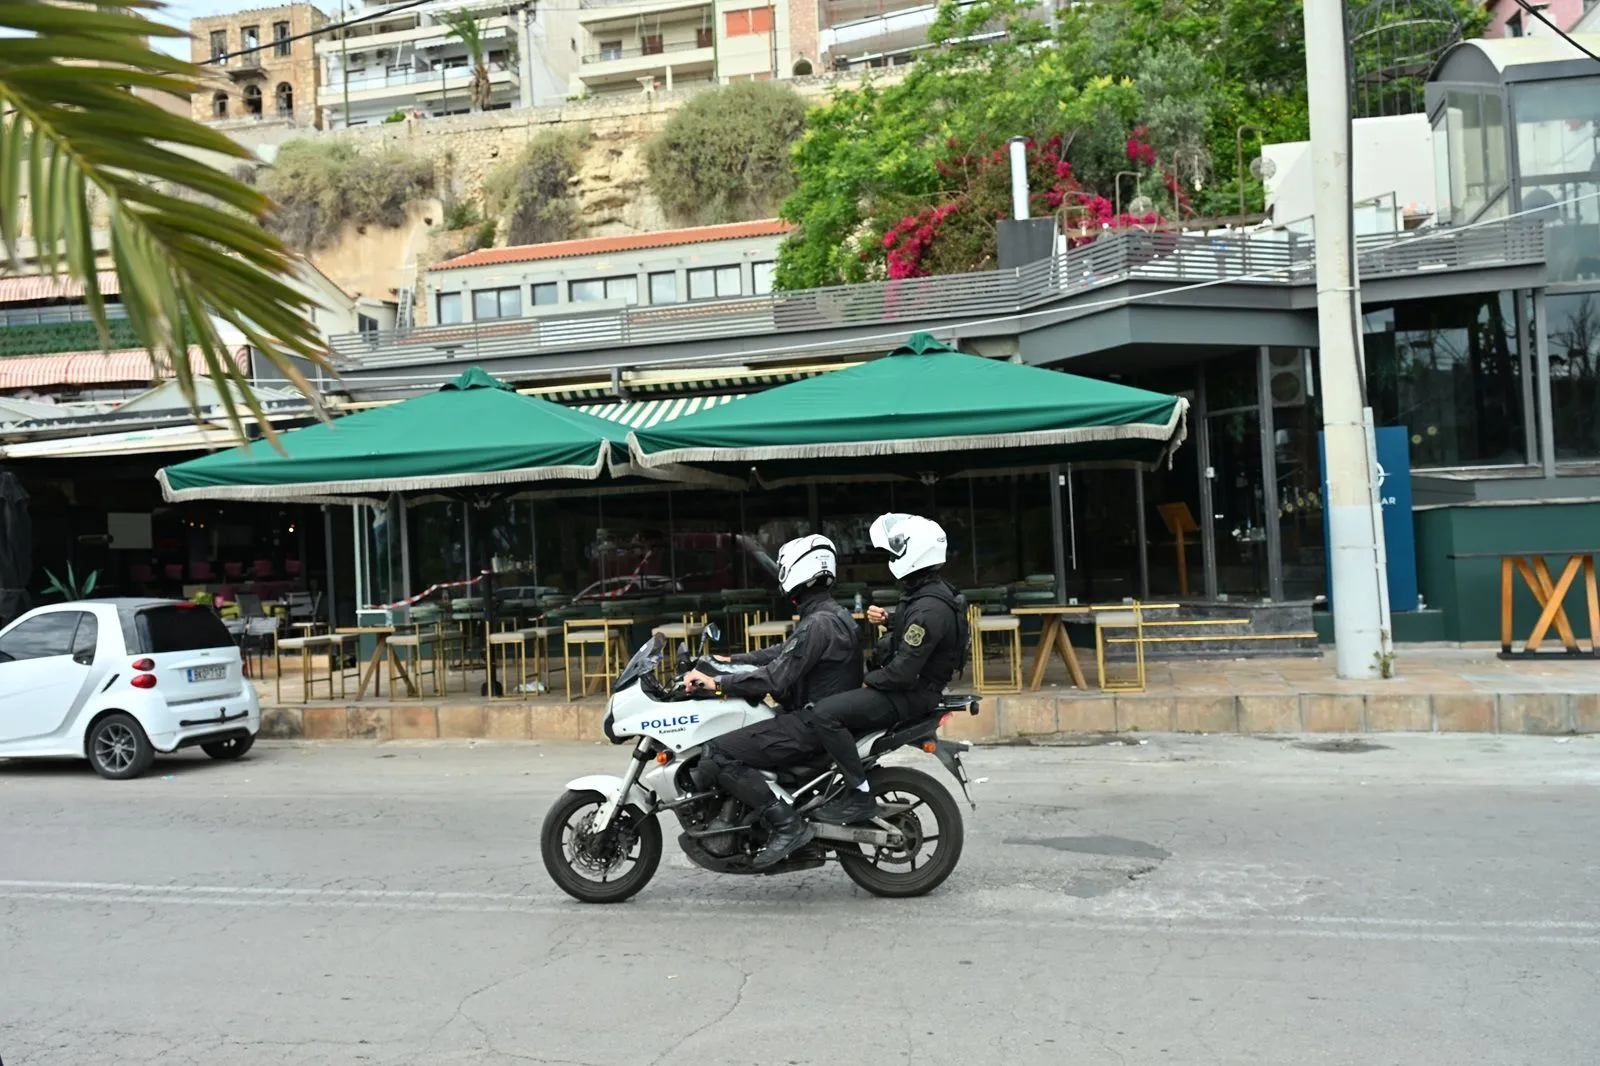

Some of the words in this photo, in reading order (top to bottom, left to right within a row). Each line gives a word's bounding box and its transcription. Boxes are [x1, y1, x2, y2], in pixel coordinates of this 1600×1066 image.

[1381, 496, 1396, 505] AR
[641, 714, 700, 730] POLICE
[658, 727, 686, 735] Kawasaki
